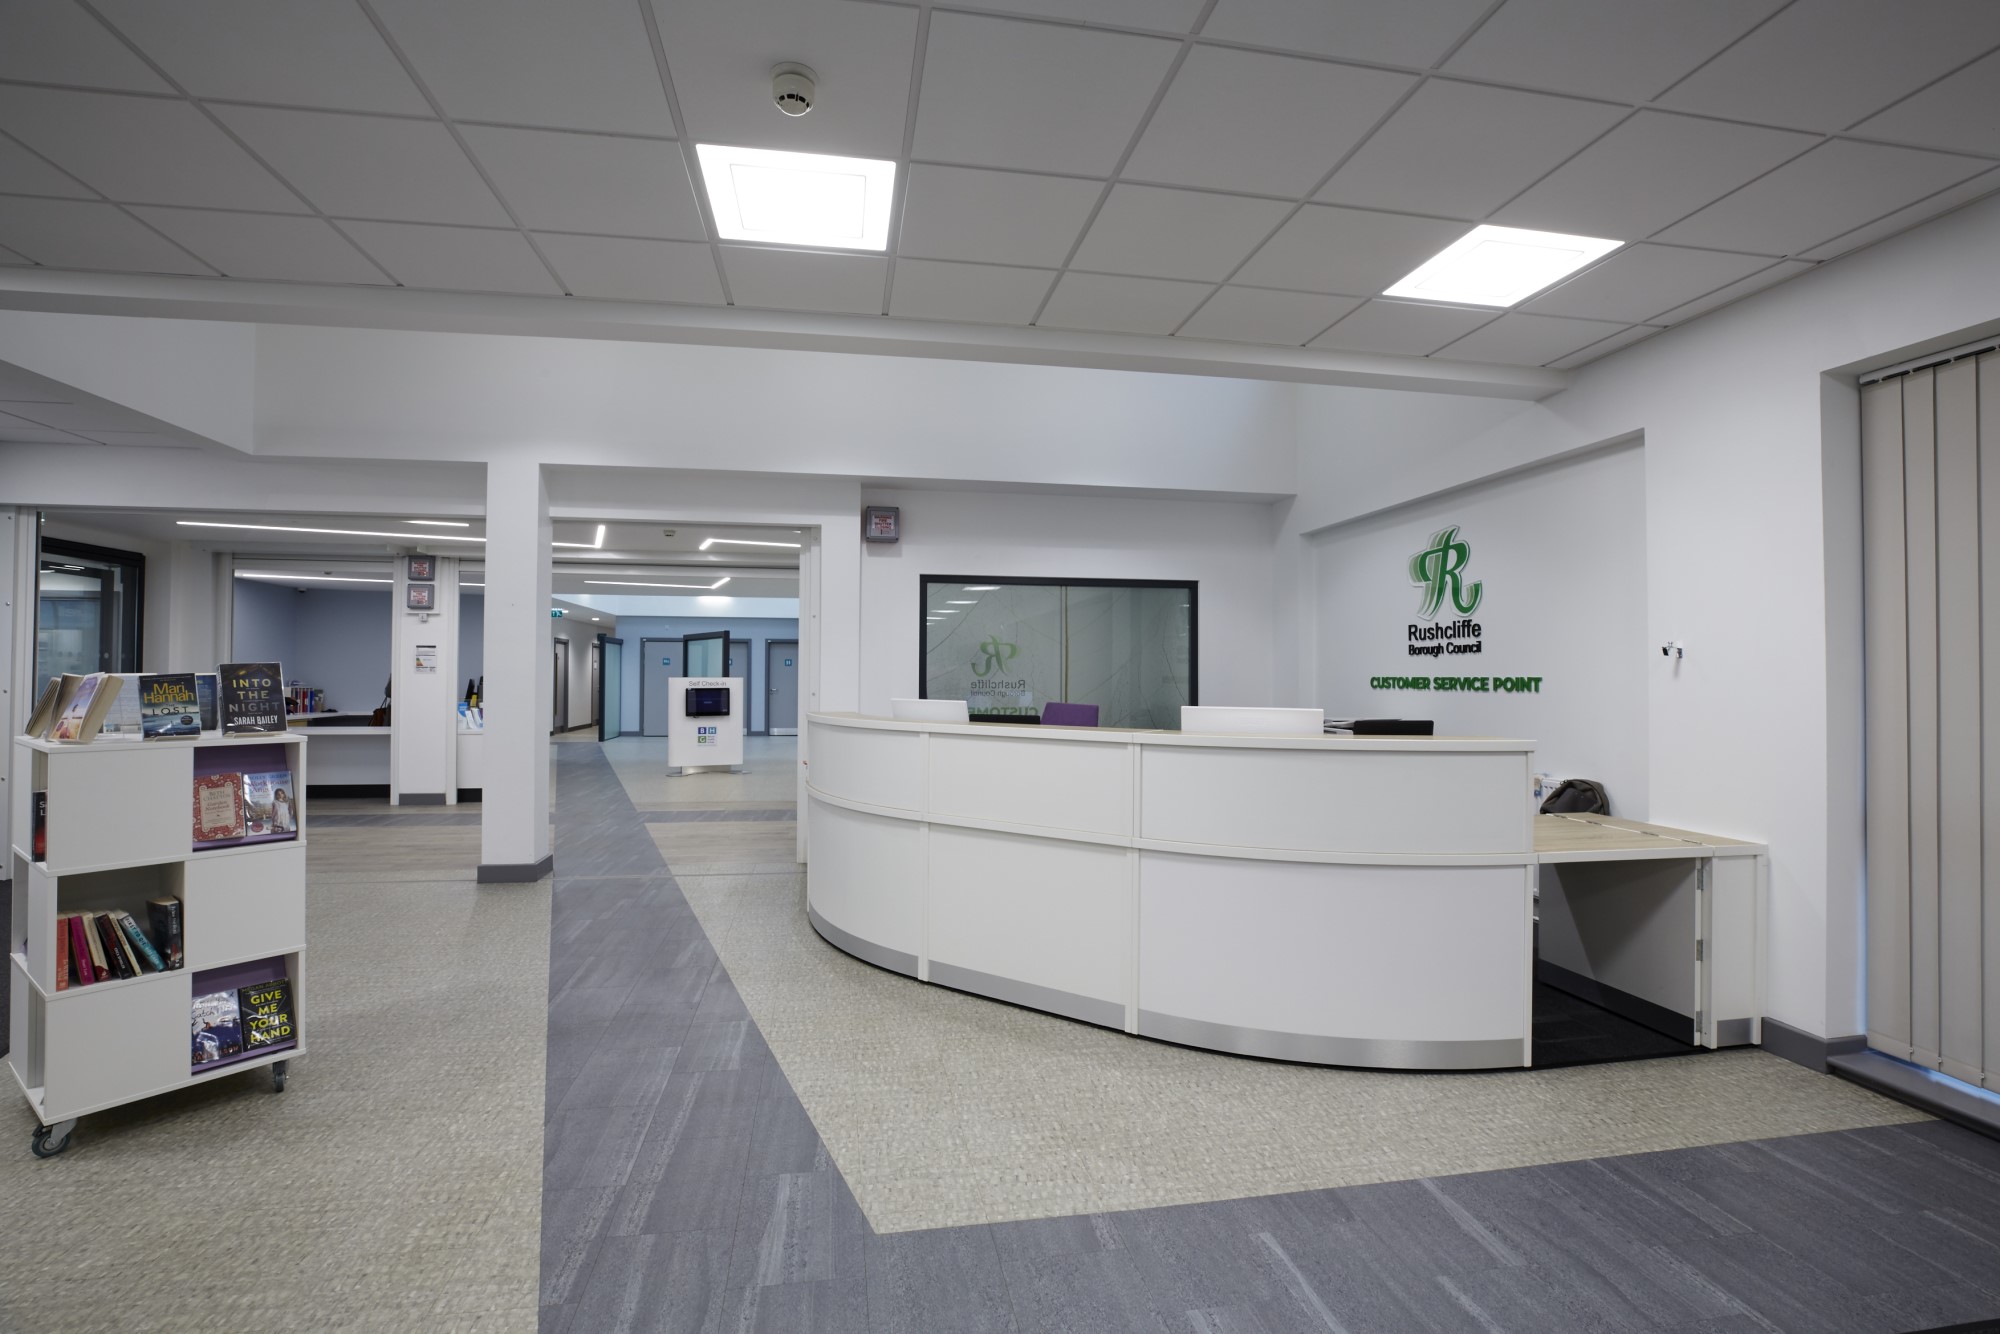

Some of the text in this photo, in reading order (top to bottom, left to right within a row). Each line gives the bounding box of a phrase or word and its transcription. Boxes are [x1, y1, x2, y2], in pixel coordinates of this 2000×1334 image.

[1408, 619, 1482, 641] Rushcliffe
[1408, 641, 1482, 657] Borough Council
[153, 681, 185, 695] Mari
[232, 678, 271, 688] INTO
[1370, 676, 1543, 693] CUSTOMER SERVICE POINT
[143, 690, 195, 704] Hannah
[237, 690, 270, 700] THE
[152, 706, 188, 716] LOST
[228, 702, 280, 712] NIGHT
[233, 715, 278, 725] SARAH BAILEY
[250, 989, 282, 1005] GIVE
[258, 1003, 278, 1016] ME
[249, 1014, 288, 1030] YOUR
[250, 1026, 291, 1043] HAND
